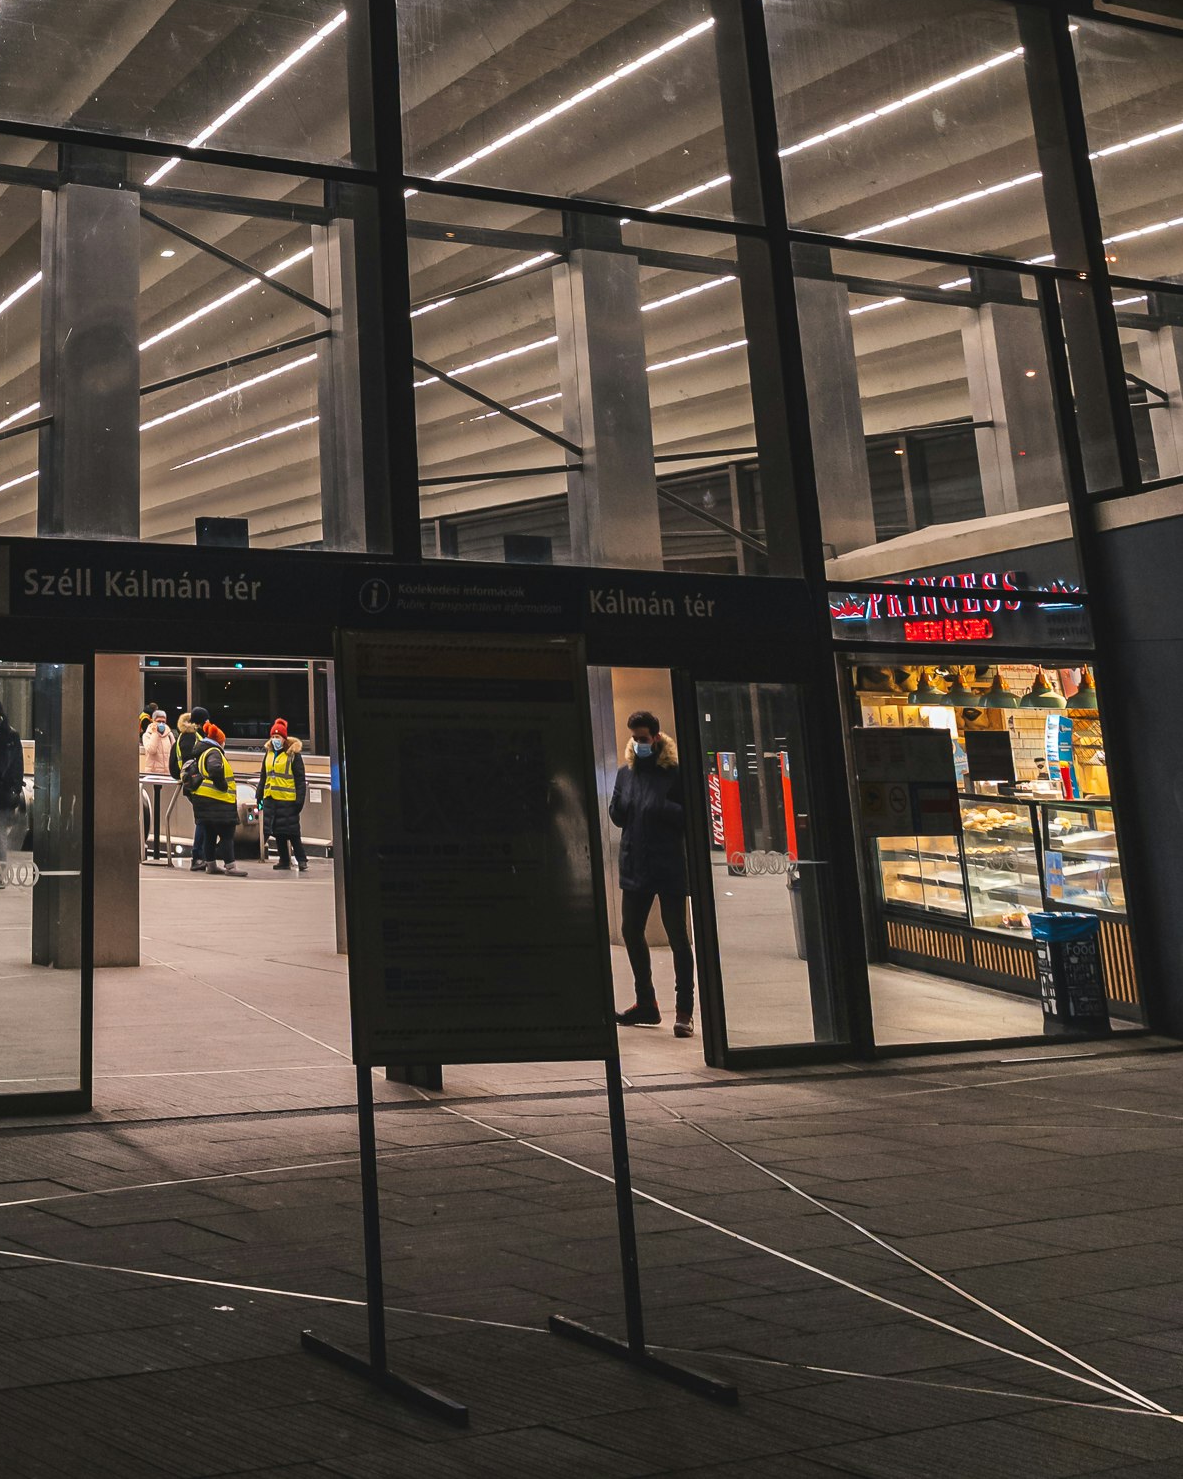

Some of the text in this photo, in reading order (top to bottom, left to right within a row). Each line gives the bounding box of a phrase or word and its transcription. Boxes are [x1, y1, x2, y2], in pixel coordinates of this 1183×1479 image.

[23, 568, 262, 602] Széll Kálmán tér
[869, 571, 1022, 620] PRINCESS
[589, 589, 715, 617] Kálmán tér
[1065, 941, 1096, 955] Food
